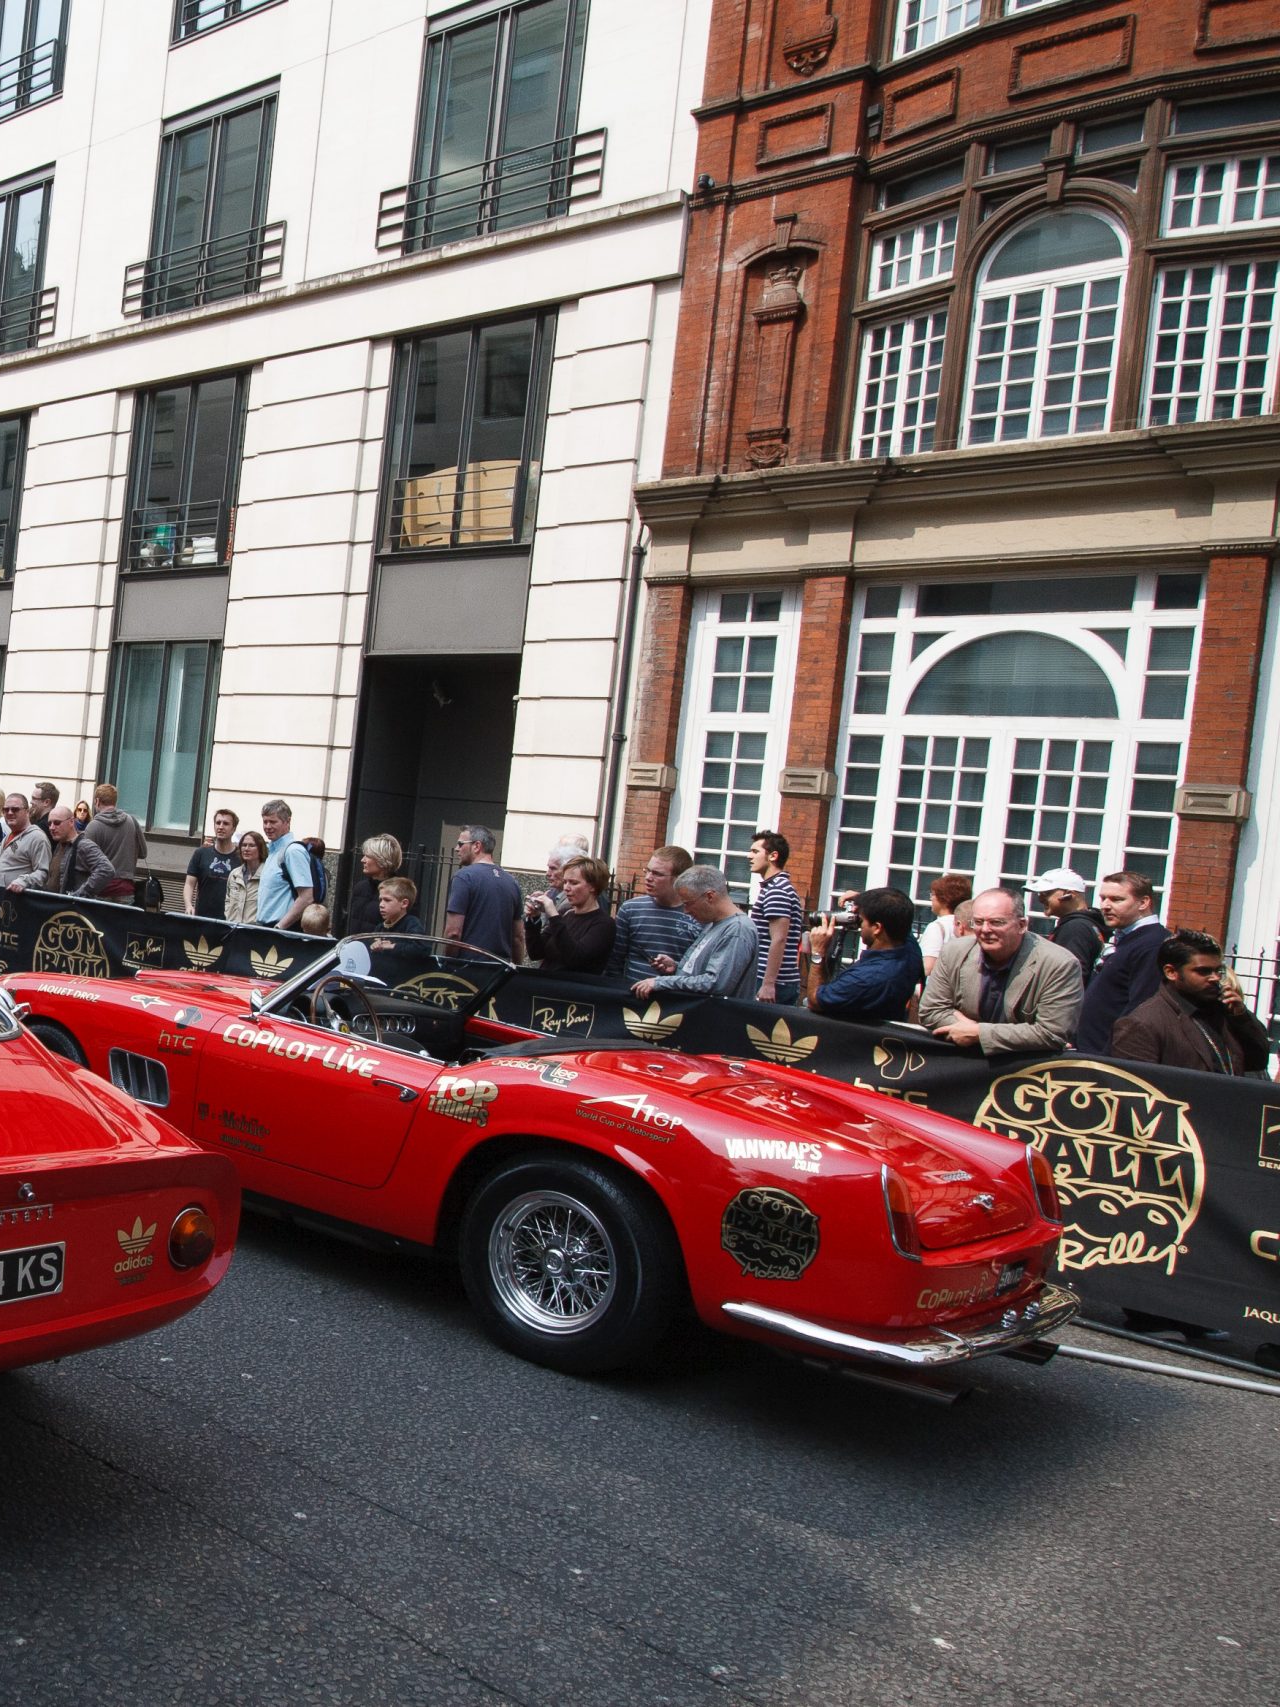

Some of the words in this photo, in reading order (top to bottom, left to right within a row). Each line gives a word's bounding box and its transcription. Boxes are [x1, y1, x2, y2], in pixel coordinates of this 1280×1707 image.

[40, 922, 103, 958] GUM
[436, 1075, 499, 1108] TOP
[427, 1094, 489, 1128] TRUMPS
[575, 1108, 598, 1121] World
[599, 1116, 615, 1128] Cup
[616, 1122, 625, 1130] of
[626, 1125, 671, 1144] Motorsport
[991, 1072, 1192, 1151] GUM
[724, 1138, 823, 1162] VANWRAPS
[17, 1252, 59, 1293] KS
[114, 1255, 153, 1273] adidas
